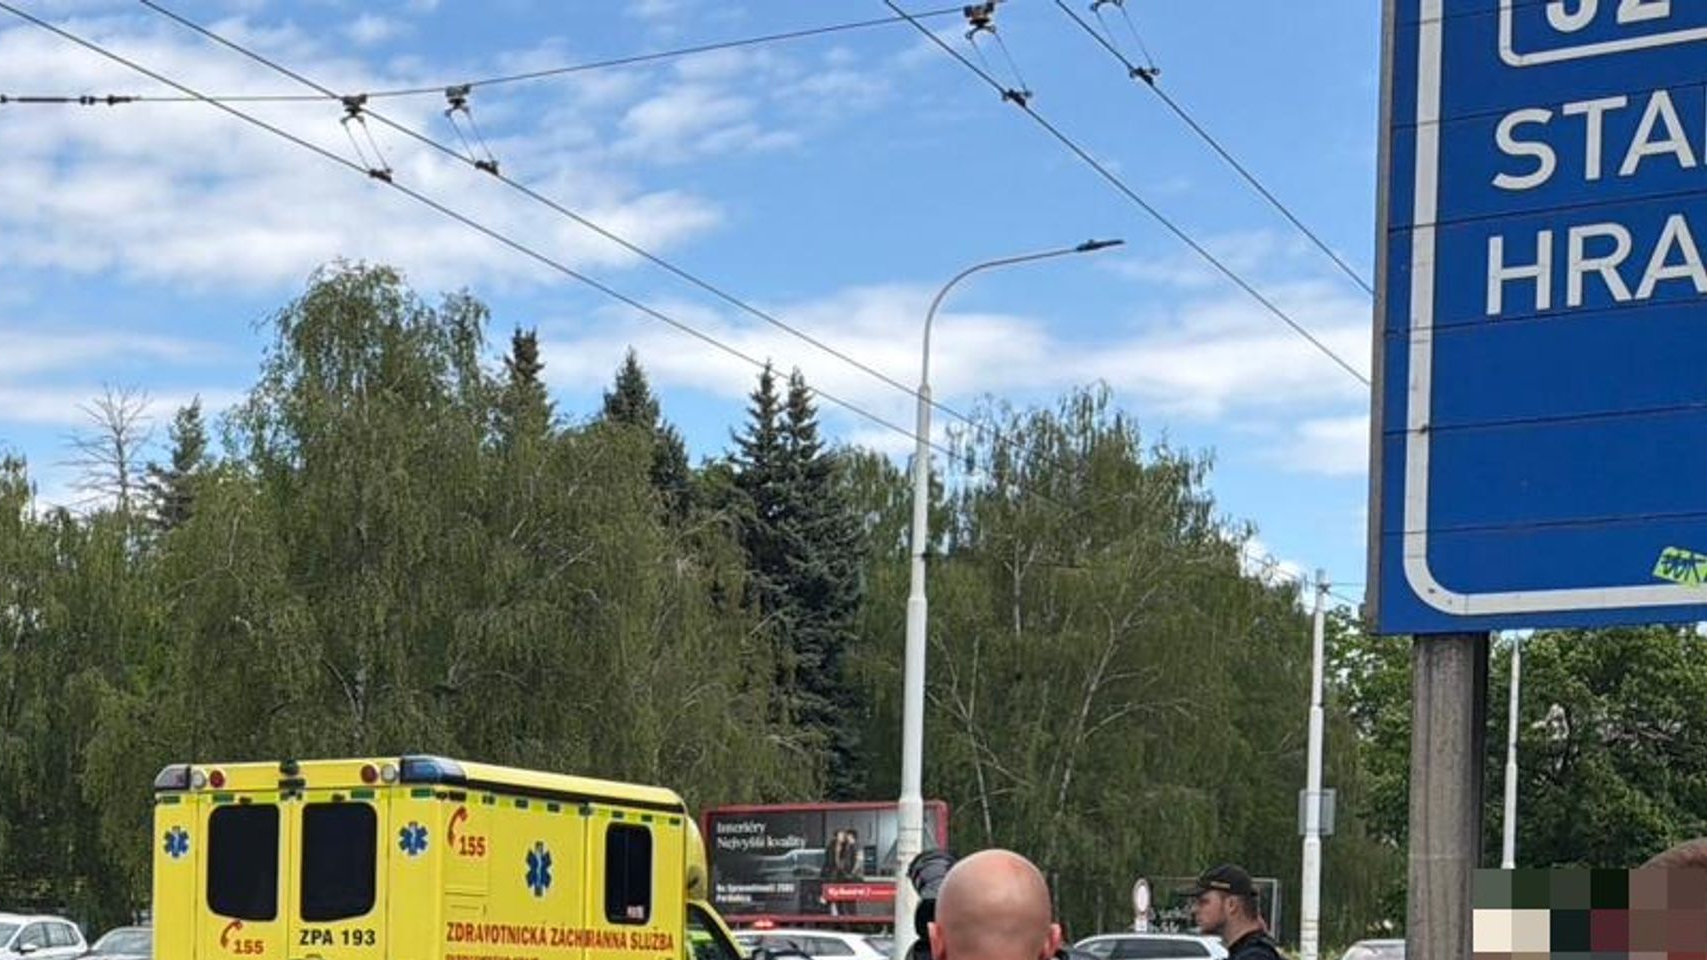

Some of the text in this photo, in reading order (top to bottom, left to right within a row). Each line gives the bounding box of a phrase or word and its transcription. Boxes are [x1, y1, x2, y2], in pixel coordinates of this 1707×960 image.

[1491, 88, 1707, 190] STA
[460, 835, 485, 857] 155
[234, 939, 264, 955] 155
[299, 929, 376, 946] ZPA 193
[446, 921, 547, 946] ZDRAVOTNICKÁ
[630, 926, 674, 951] SLUŽBA
